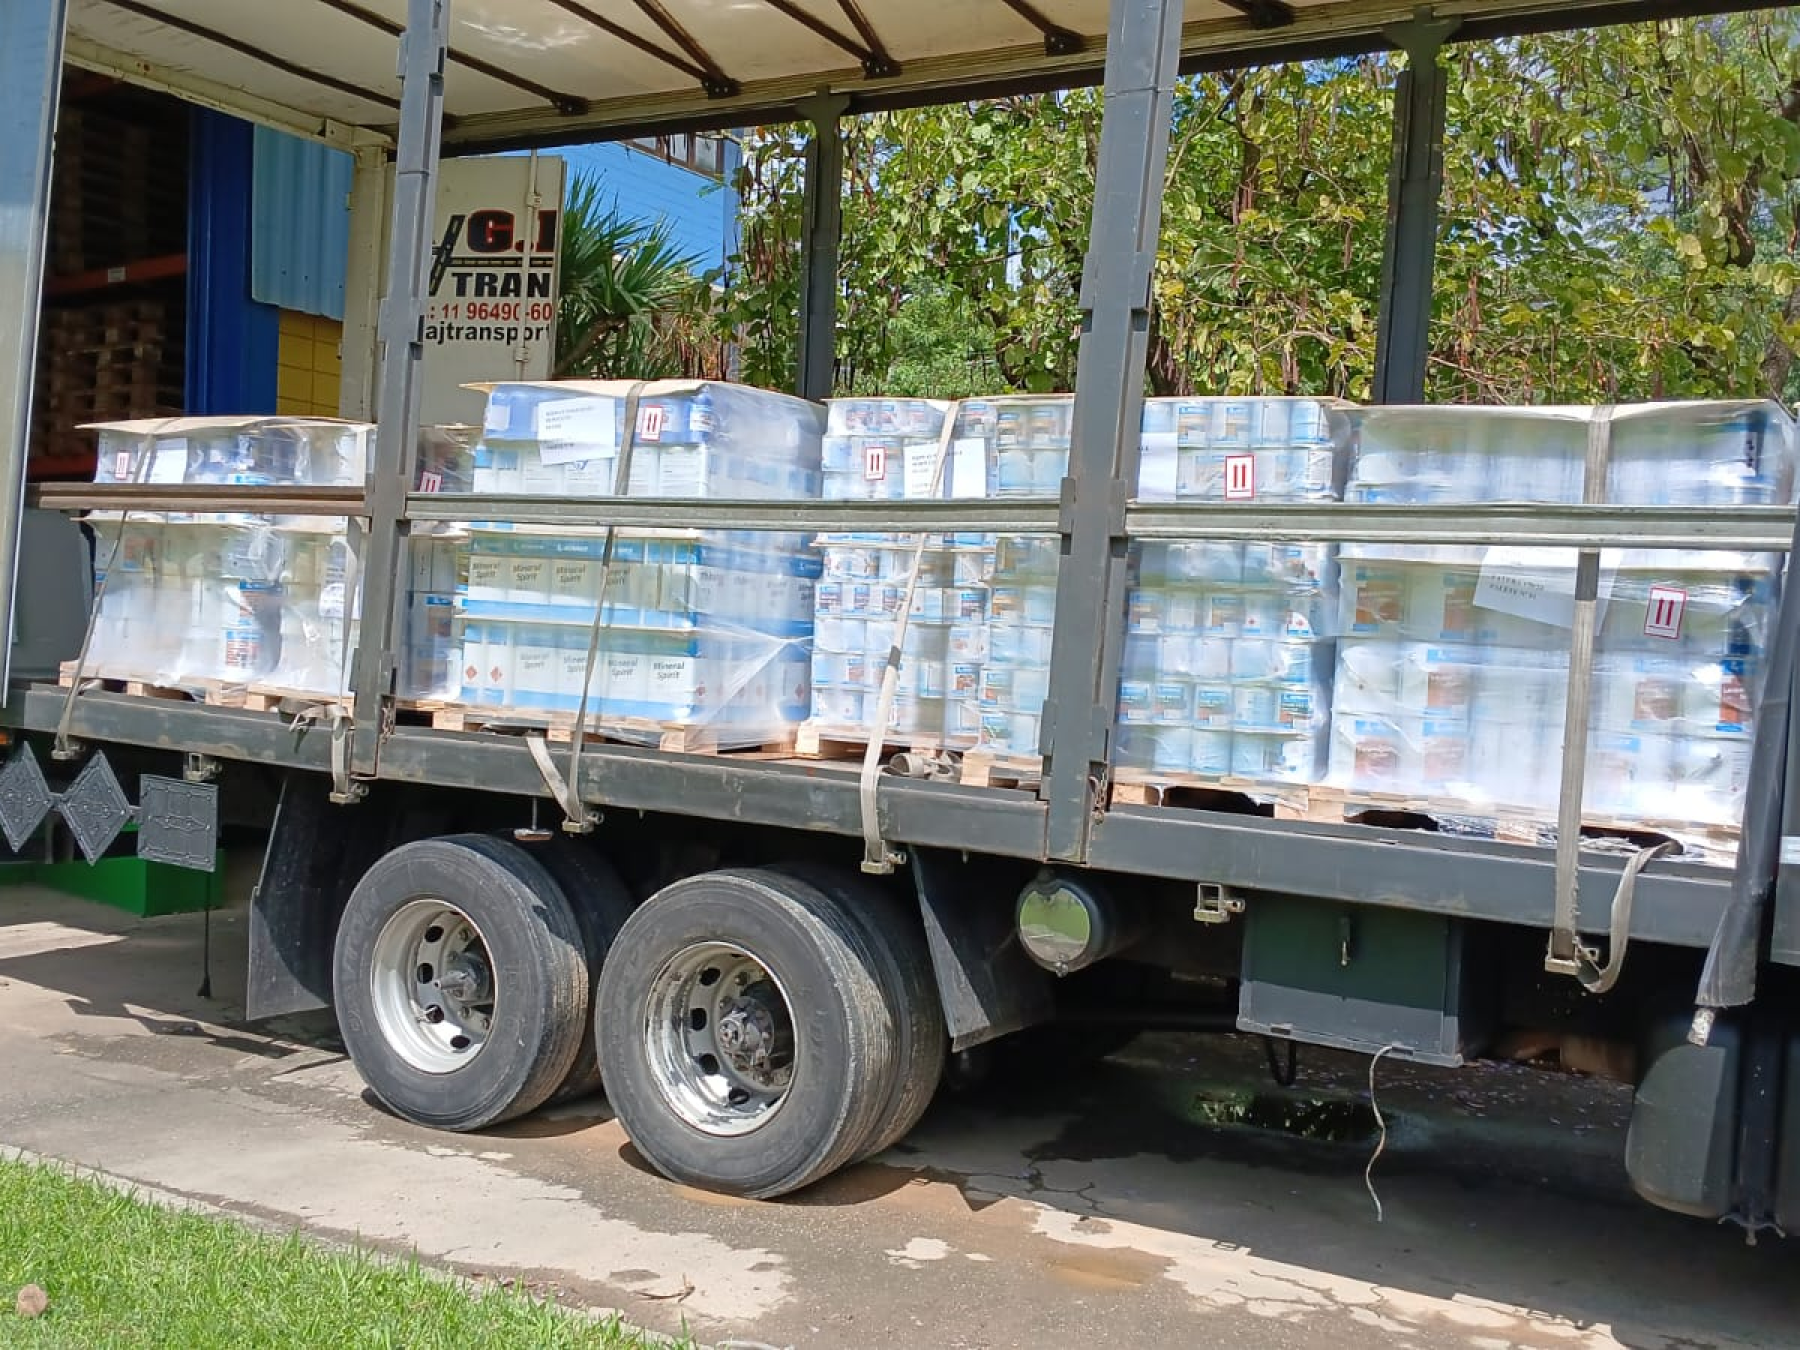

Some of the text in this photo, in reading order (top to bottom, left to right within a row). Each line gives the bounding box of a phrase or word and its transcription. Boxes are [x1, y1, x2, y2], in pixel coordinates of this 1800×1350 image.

[451, 272, 551, 297] TRAN
[442, 303, 459, 319] 11
[513, 563, 542, 573] Mineral
[556, 564, 586, 574] Mineral
[516, 572, 538, 582] Spirit
[608, 657, 638, 667] Mineral
[653, 661, 685, 670] Mineral
[611, 668, 634, 679] Spirit
[656, 671, 681, 682] Spirit
